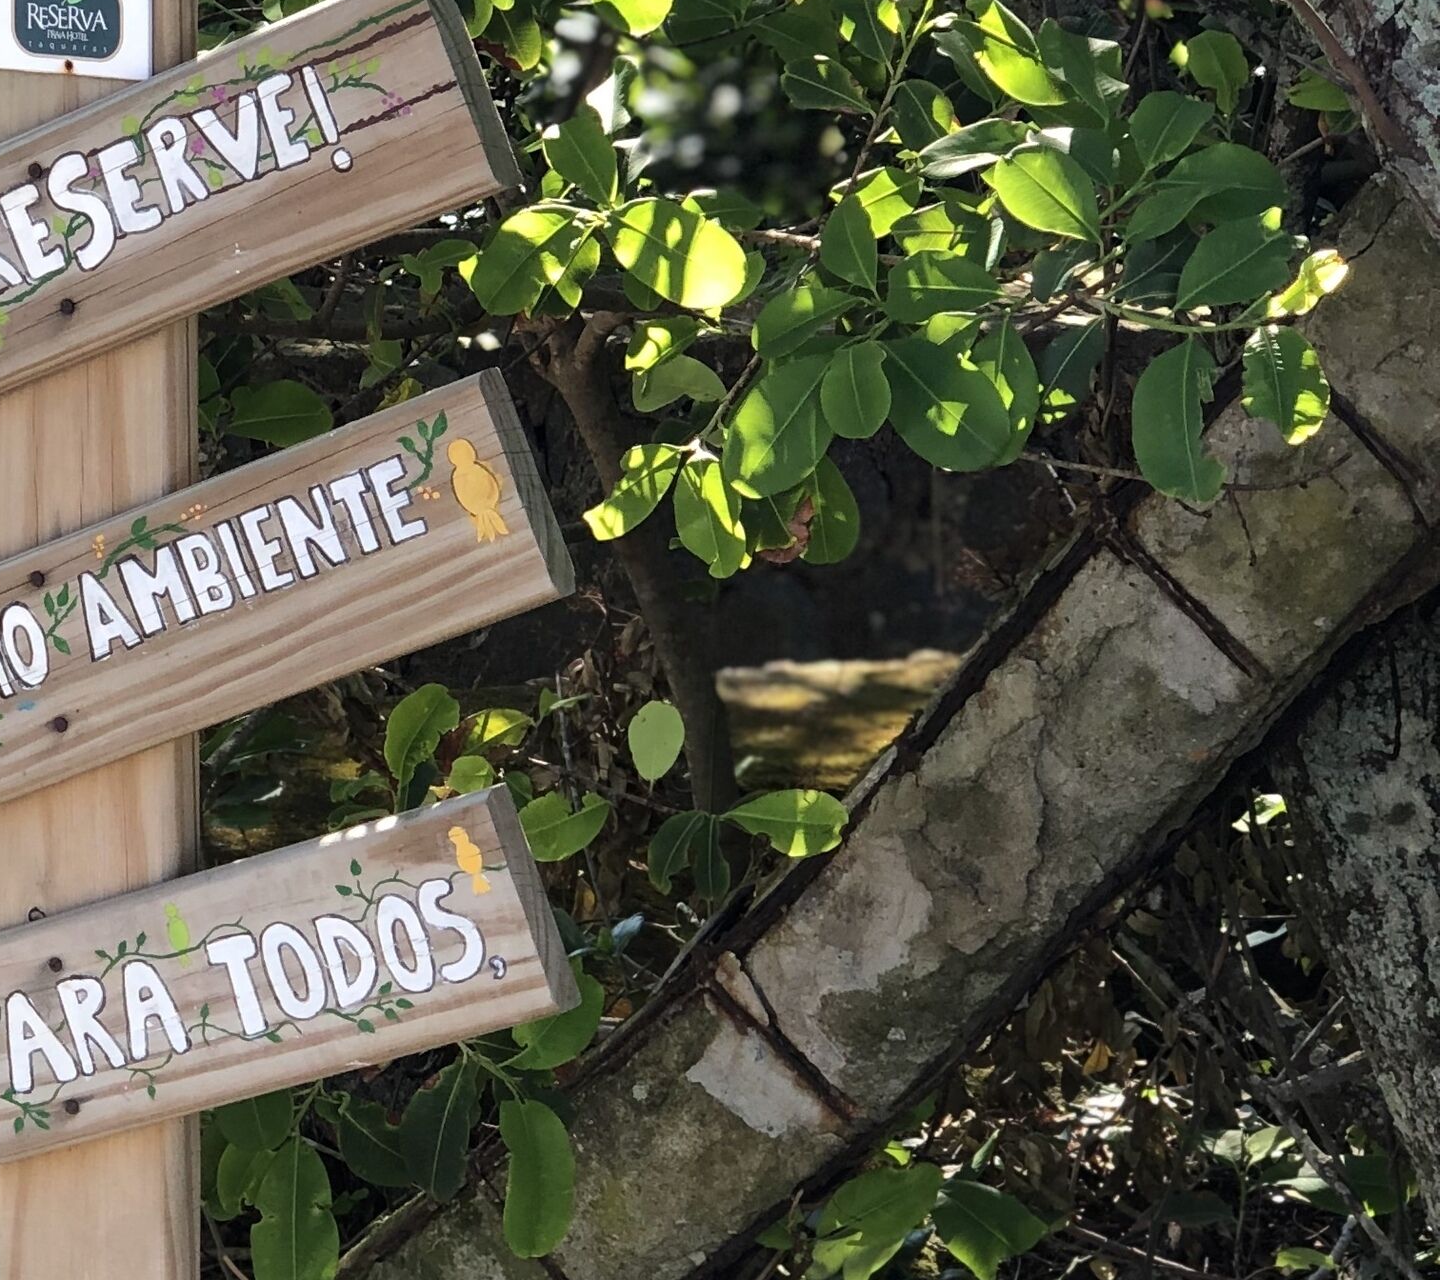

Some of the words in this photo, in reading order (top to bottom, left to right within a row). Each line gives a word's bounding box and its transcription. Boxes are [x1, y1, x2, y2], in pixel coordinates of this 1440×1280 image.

[27, 2, 108, 32] RESERVA
[77, 454, 429, 664] AMBIENTE
[207, 877, 509, 1039] TODOS,
